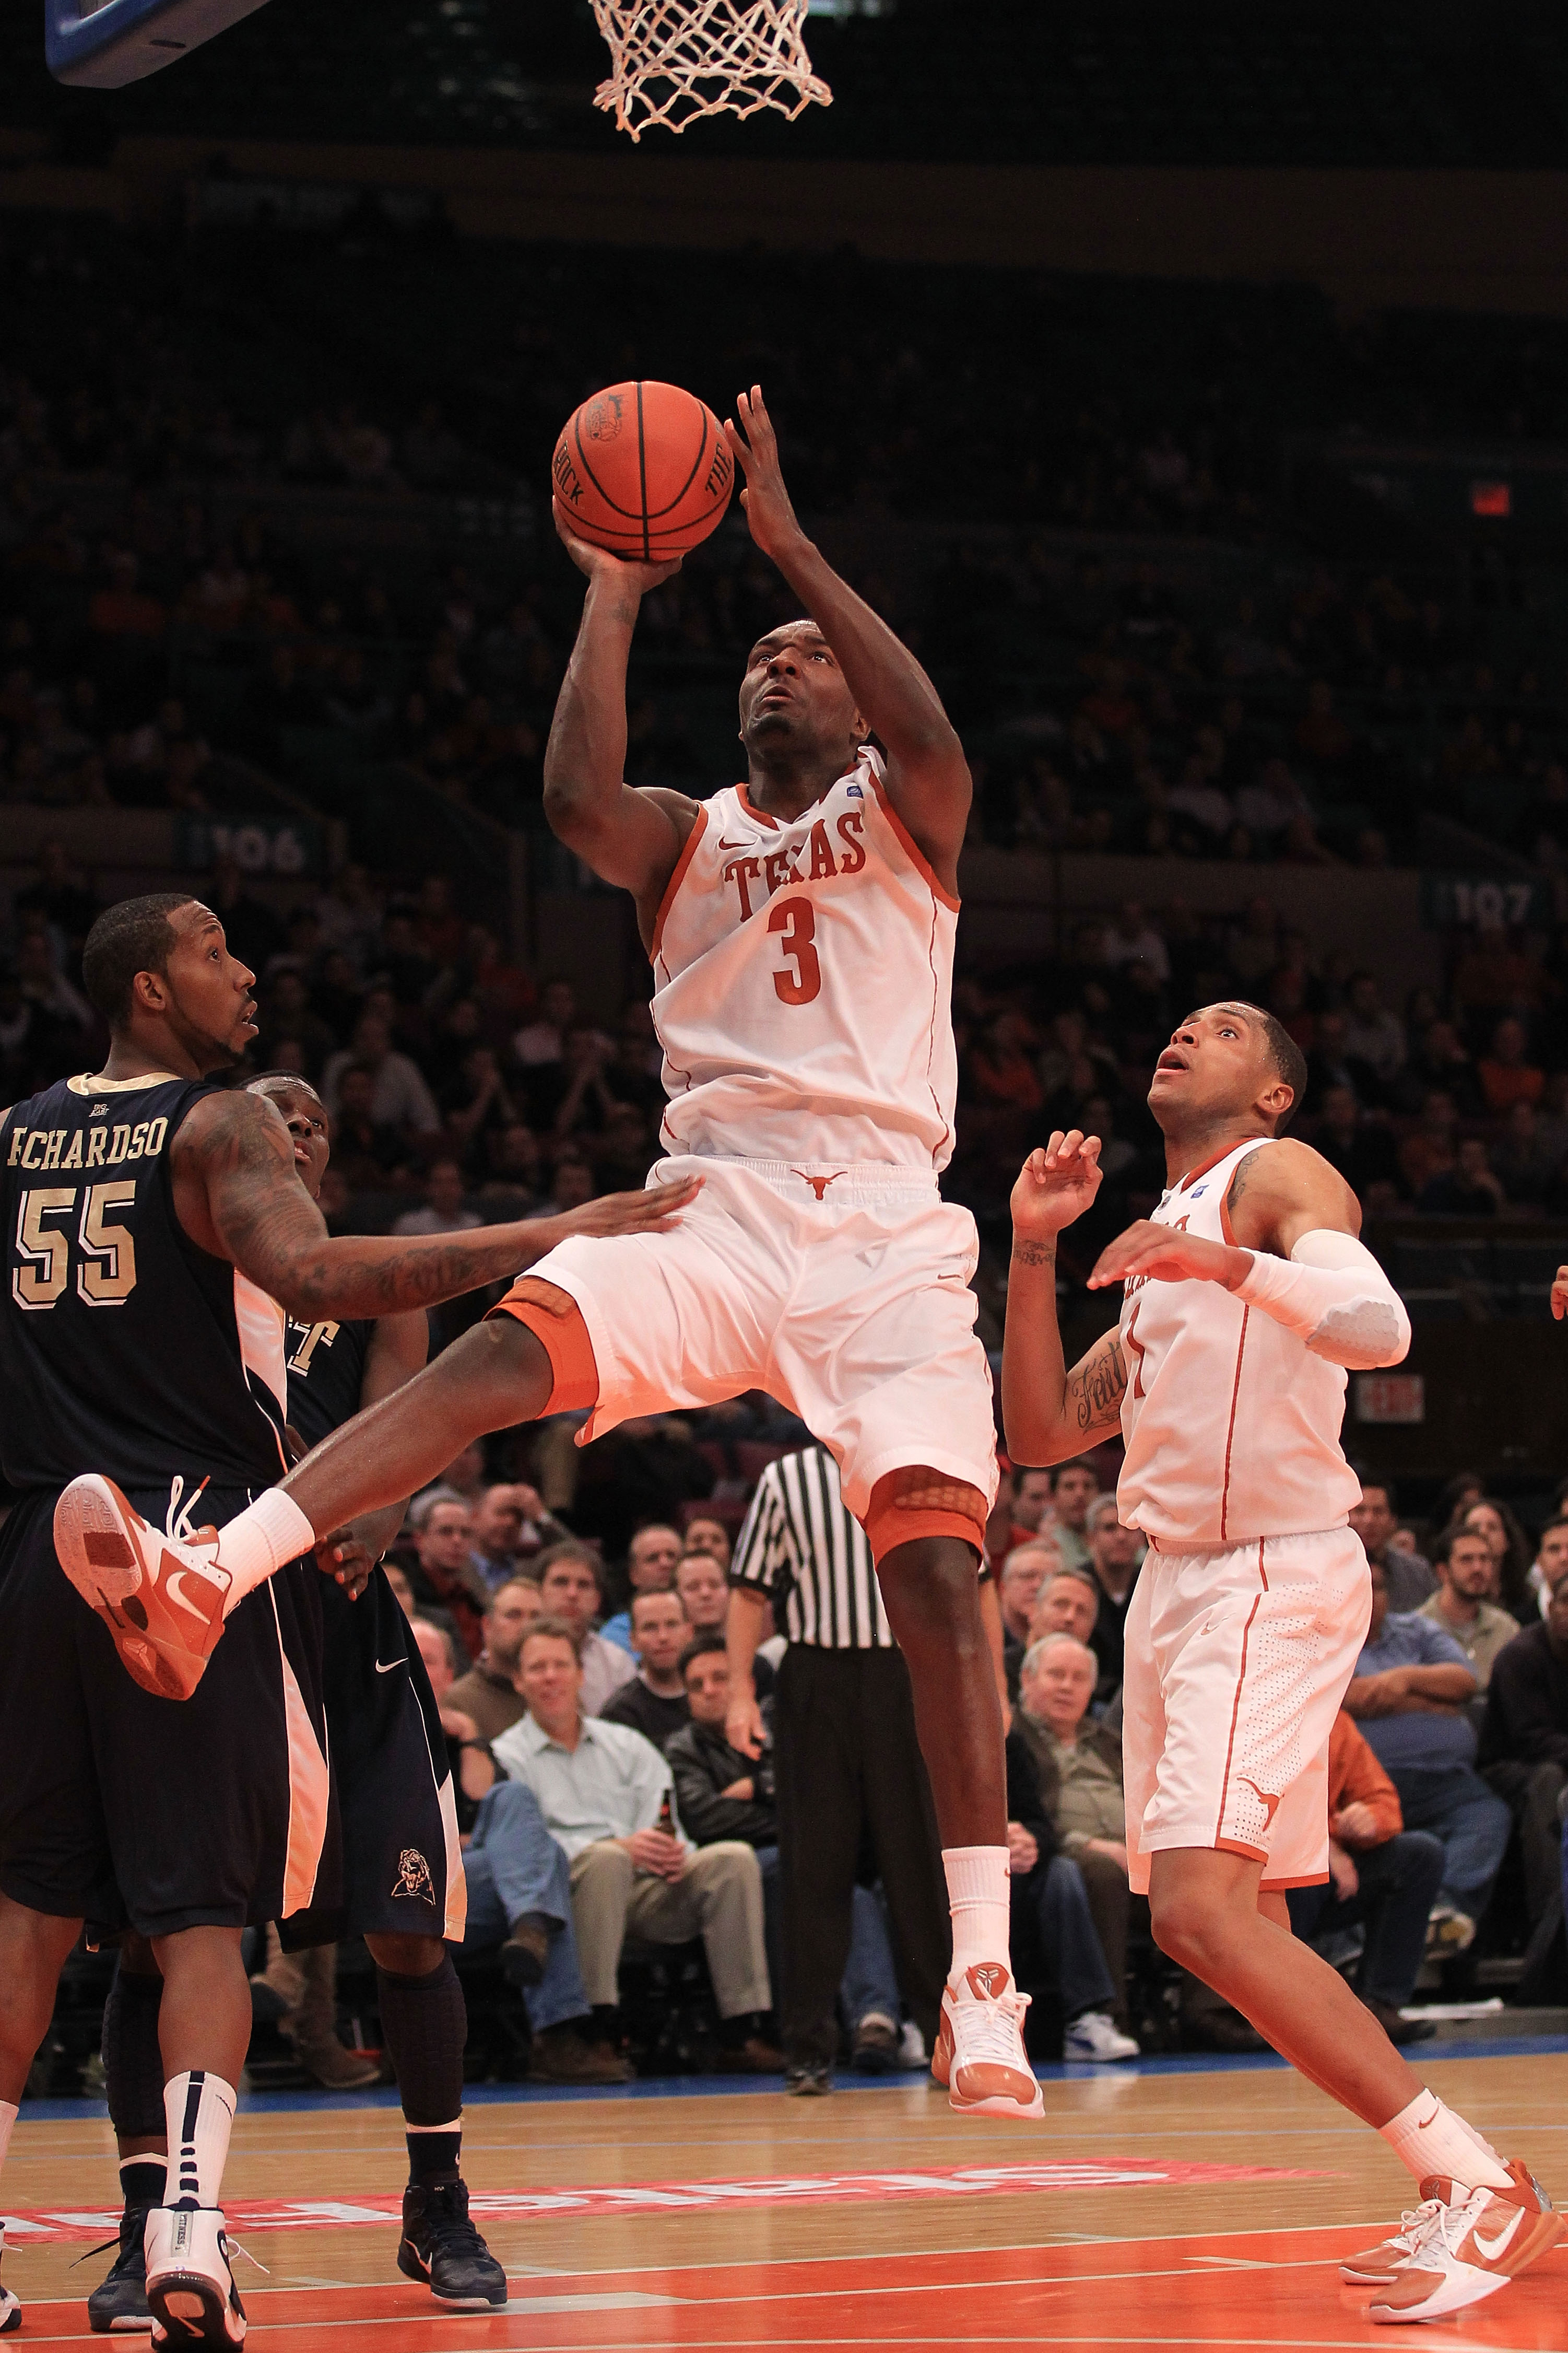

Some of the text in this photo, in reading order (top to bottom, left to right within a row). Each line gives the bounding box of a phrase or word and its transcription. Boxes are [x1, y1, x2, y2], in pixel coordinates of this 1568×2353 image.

[724, 812, 866, 922] TEXAS
[1454, 881, 1532, 923] 107
[766, 897, 821, 1006] 3
[13, 1180, 137, 1310] 55
